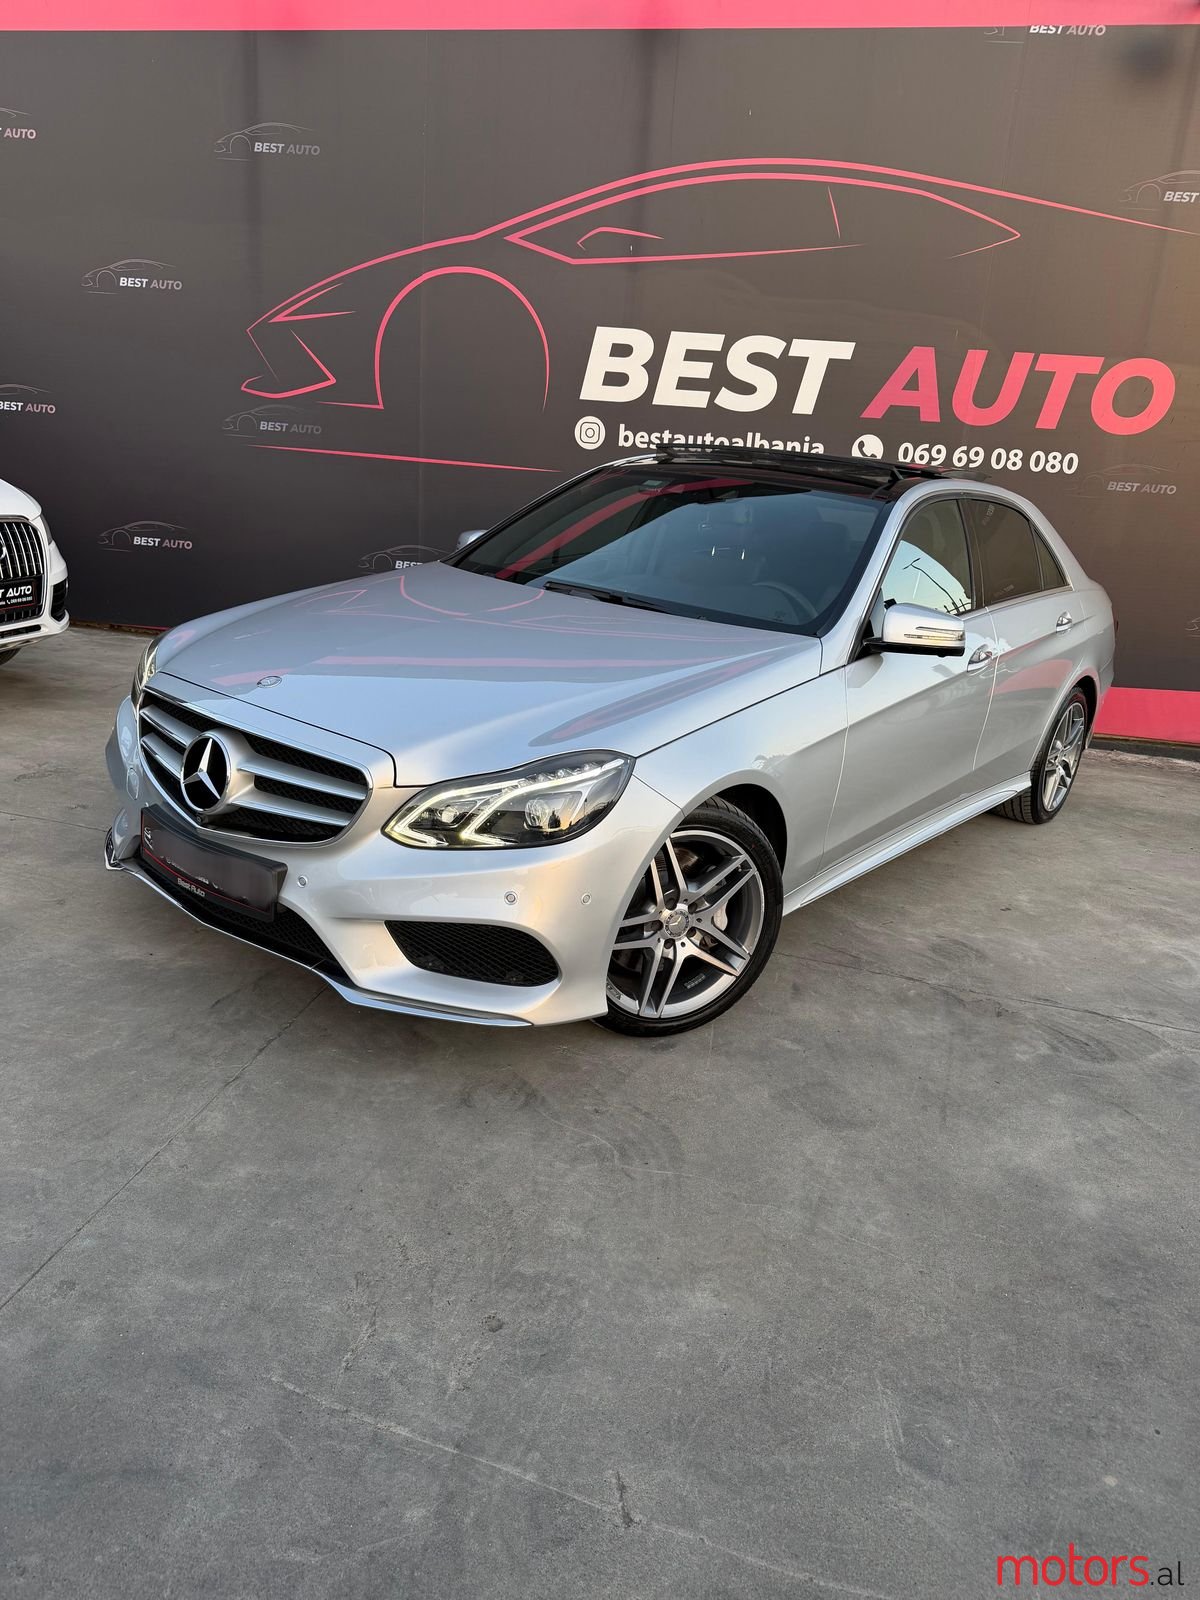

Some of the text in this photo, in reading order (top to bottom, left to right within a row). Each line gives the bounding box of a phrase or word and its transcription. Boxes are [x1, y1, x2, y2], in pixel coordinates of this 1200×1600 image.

[1029, 24, 1106, 36] BEST AUTO
[3, 127, 37, 140] AUTO
[254, 142, 321, 156] BEST AUTO
[1163, 191, 1200, 203] BEST
[119, 277, 183, 290] BEST AUTO
[579, 326, 1176, 436] BEST AUTO
[25, 403, 56, 414] AUTO
[260, 421, 322, 434] BEST AUTO
[897, 442, 1079, 475] 069 69 08 080
[1107, 481, 1177, 495] BEST AUTO
[133, 536, 193, 550] BEST AUTO
[6, 585, 32, 598] AUTO
